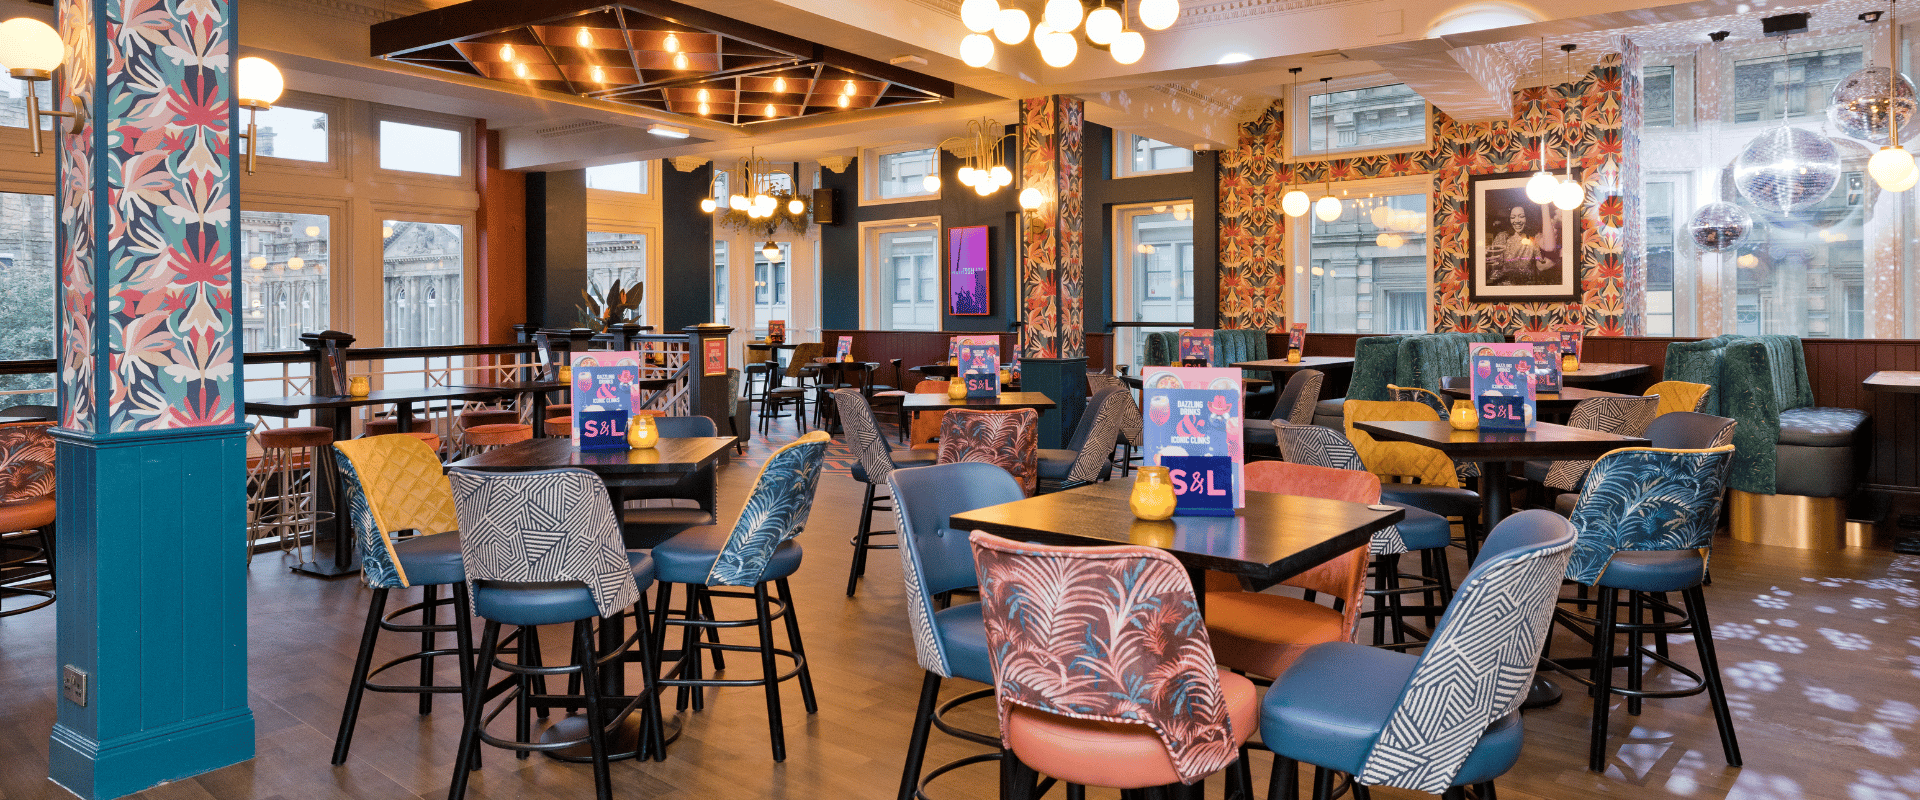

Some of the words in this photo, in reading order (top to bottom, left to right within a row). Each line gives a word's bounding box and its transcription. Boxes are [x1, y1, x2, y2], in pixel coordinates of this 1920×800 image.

[968, 379, 994, 391] S&L
[1177, 400, 1204, 409] DAZZLING
[1483, 403, 1521, 420] S&L
[584, 419, 625, 438] S&L
[1170, 436, 1189, 444] ICONIC
[1190, 435, 1211, 444] CLINKS
[1169, 468, 1226, 496] S&L
